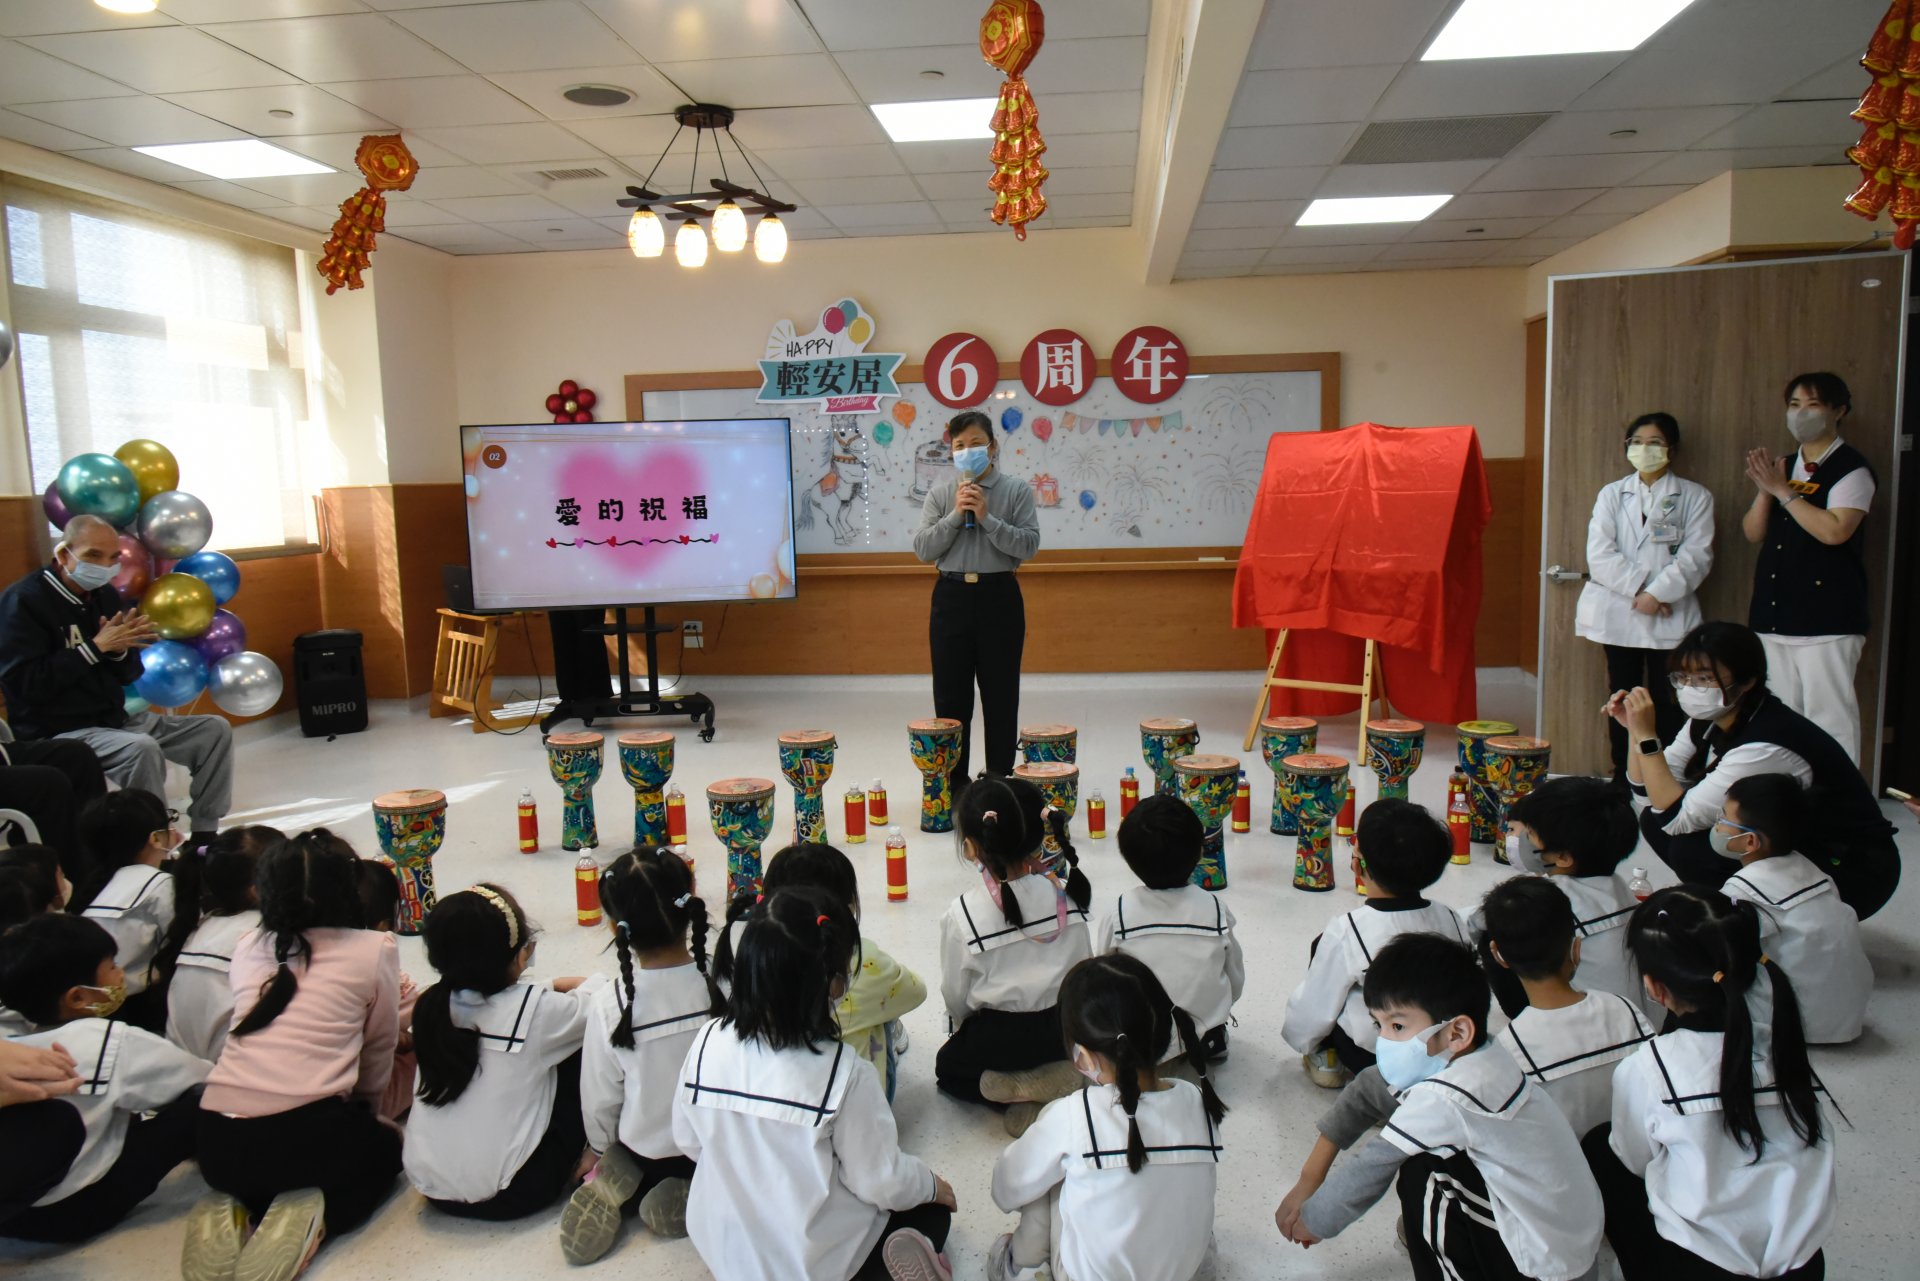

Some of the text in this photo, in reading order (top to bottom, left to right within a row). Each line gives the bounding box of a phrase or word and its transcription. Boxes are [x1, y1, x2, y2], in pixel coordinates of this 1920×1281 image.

[786, 337, 834, 358] HAPPY
[776, 359, 882, 397] 輕安居
[830, 396, 869, 409] Birthday
[488, 452, 501, 462] 02
[555, 495, 708, 526] 愛的祝福
[311, 701, 357, 716] MIPRO
